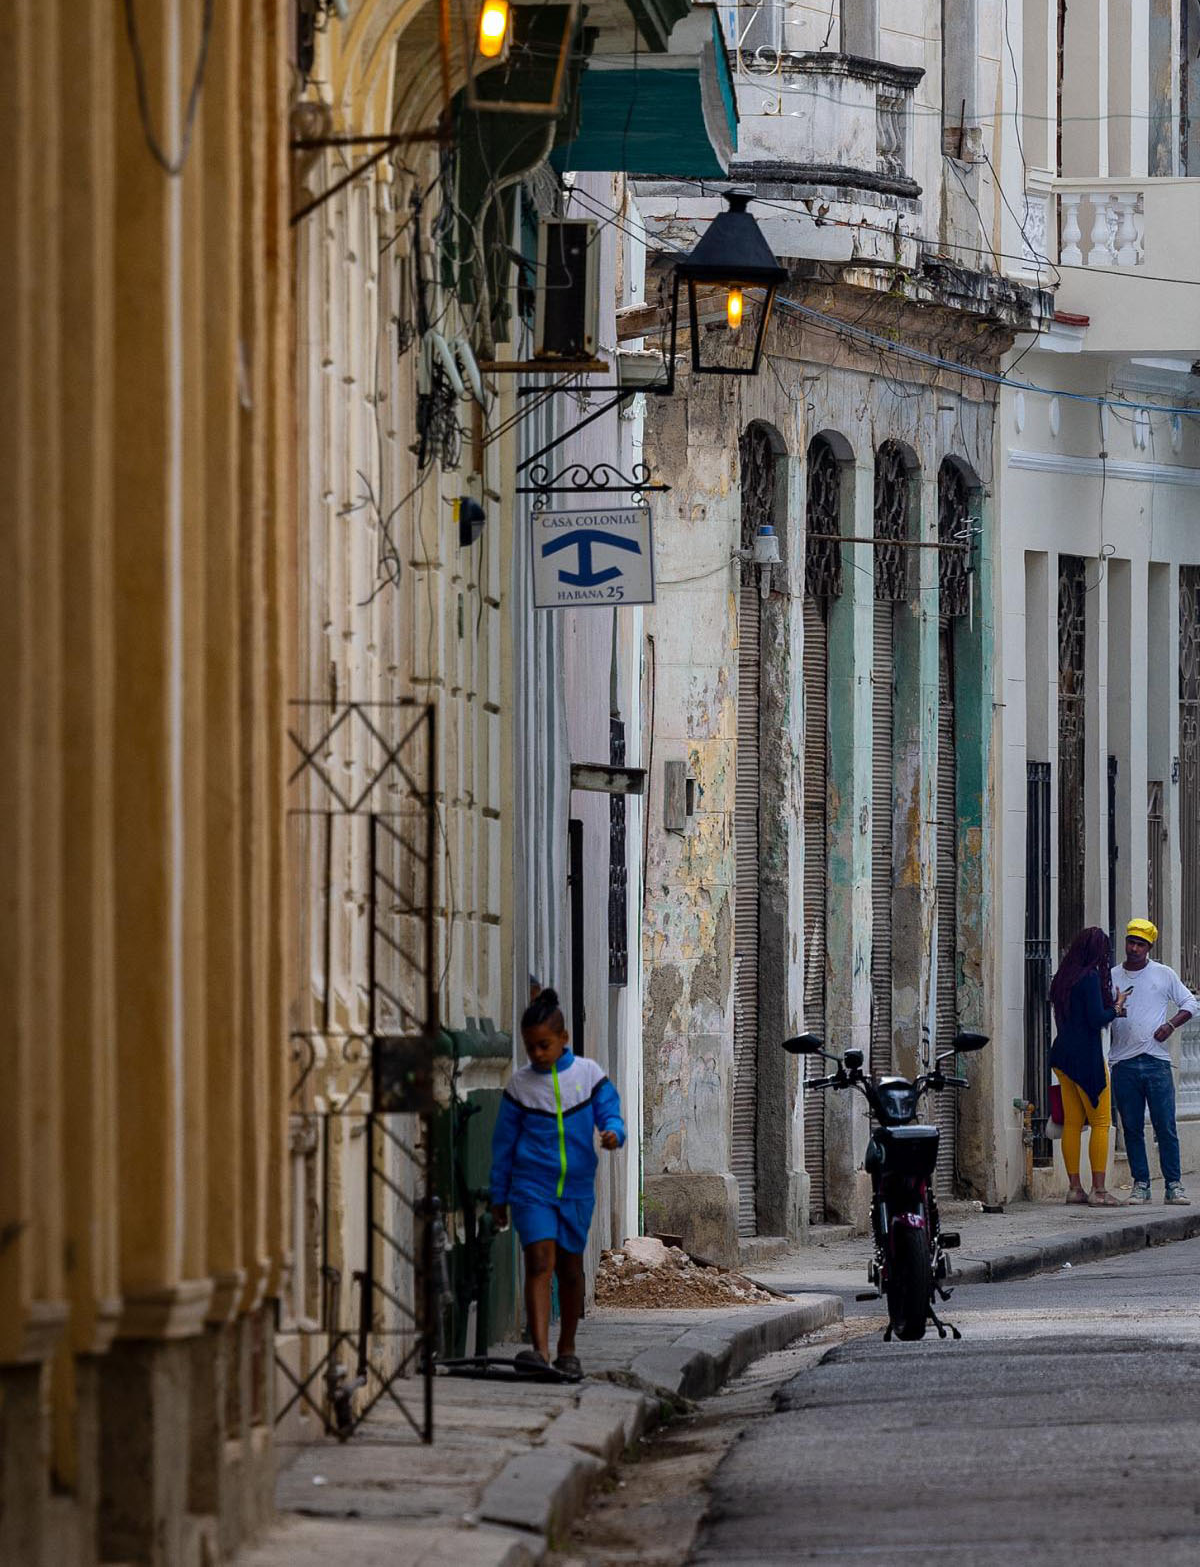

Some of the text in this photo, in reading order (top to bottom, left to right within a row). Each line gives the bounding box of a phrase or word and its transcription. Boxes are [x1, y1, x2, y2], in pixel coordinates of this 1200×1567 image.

[542, 514, 639, 528] CASA COLONIAL
[558, 586, 625, 601] HABANA 25
